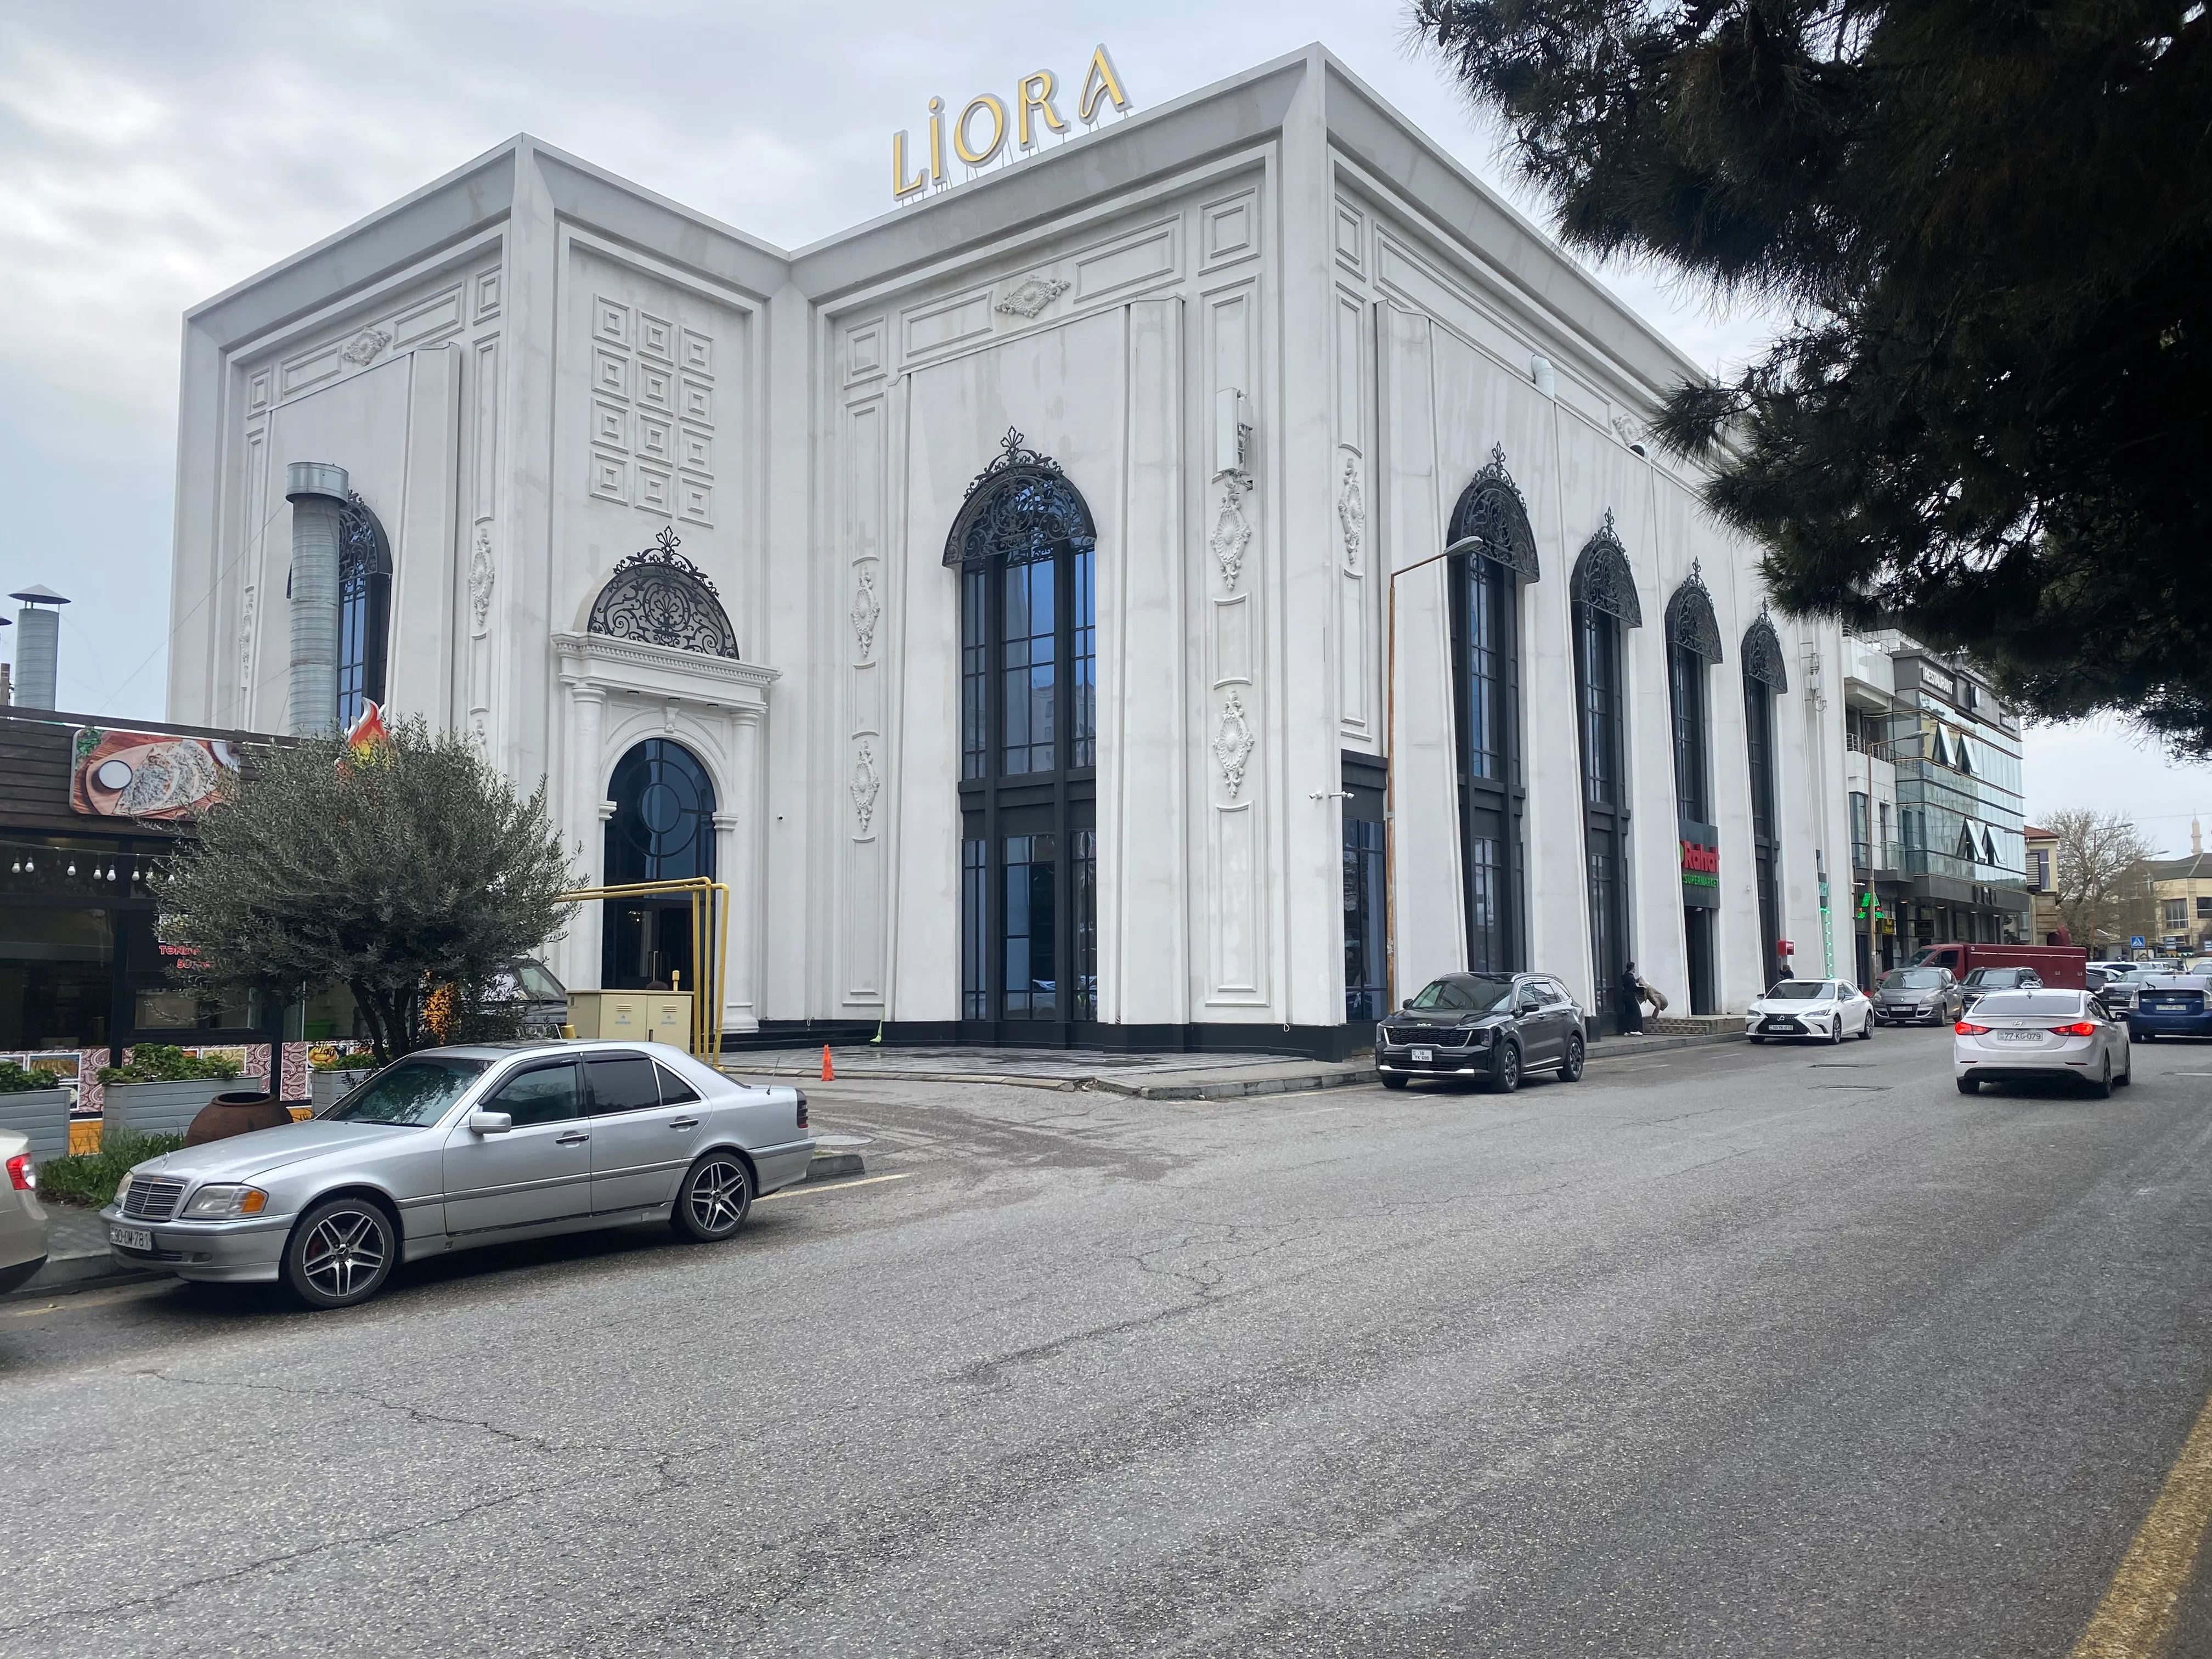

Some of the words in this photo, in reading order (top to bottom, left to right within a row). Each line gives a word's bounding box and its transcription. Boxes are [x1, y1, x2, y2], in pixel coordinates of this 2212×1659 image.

[1924, 667, 1953, 695] RESTAURANT
[1682, 840, 1719, 873] Rahat
[1684, 874, 1718, 888] SUPERMARKET
